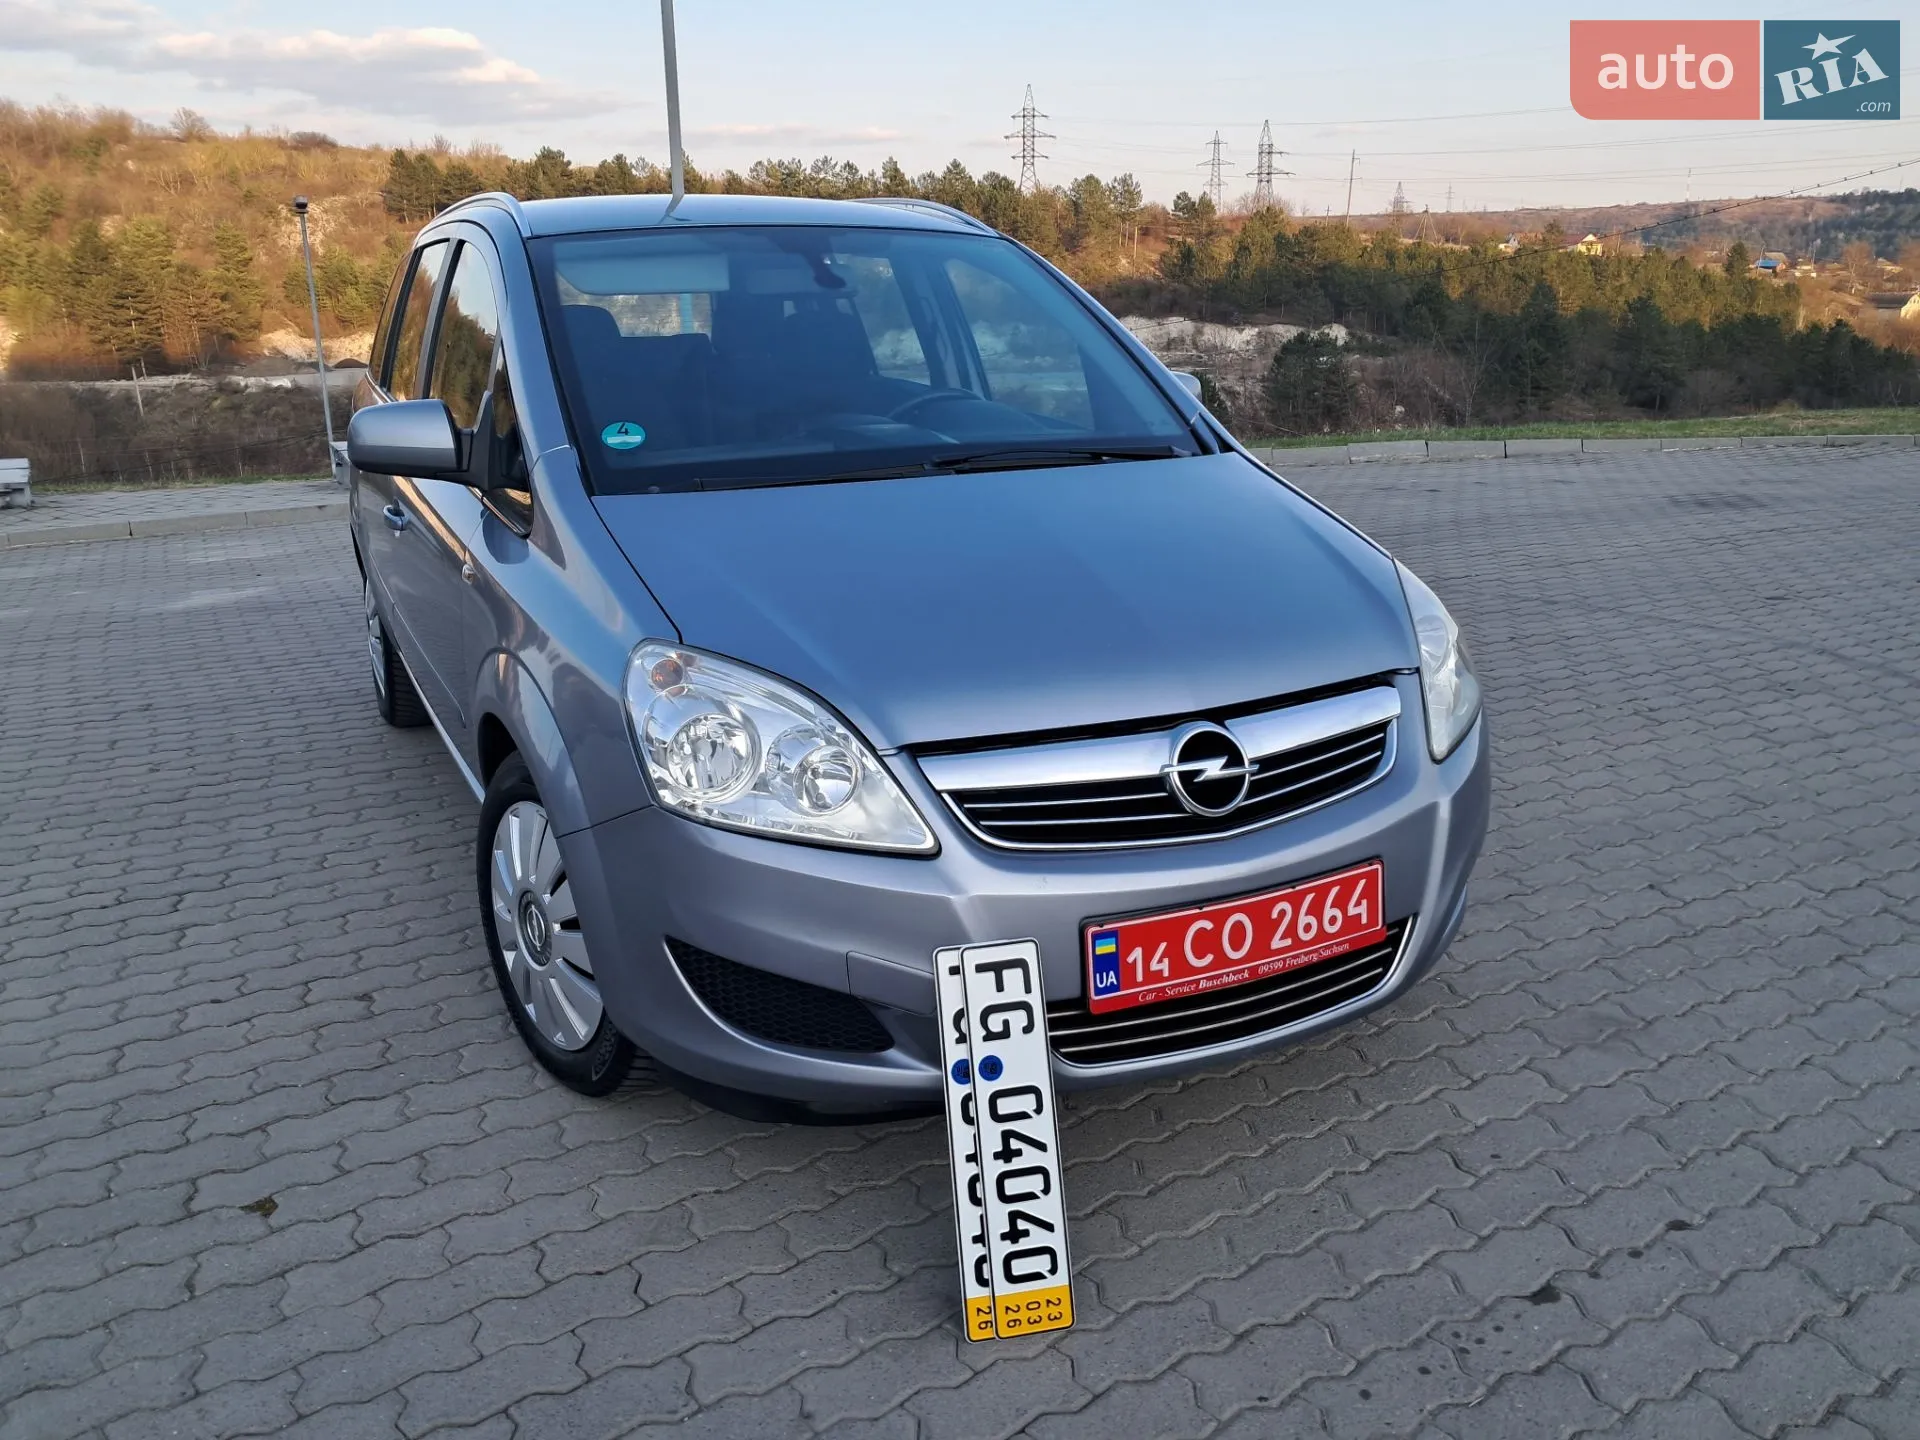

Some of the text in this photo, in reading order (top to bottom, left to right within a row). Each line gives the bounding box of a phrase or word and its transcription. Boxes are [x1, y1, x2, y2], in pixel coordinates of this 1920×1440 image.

[617, 422, 630, 436] 4
[1126, 878, 1368, 982] 14 CO 2664
[1198, 969, 1250, 989] Buschbeck
[1257, 960, 1284, 975] 09599
[1319, 942, 1350, 958] Sachsen
[1096, 971, 1118, 989] UA
[974, 957, 1035, 1043] FG
[987, 1084, 1058, 1285] 04040
[975, 1305, 993, 1331] 26
[1004, 1303, 1022, 1329] 26
[1025, 1300, 1043, 1325] 03
[1045, 1296, 1063, 1322] 23
